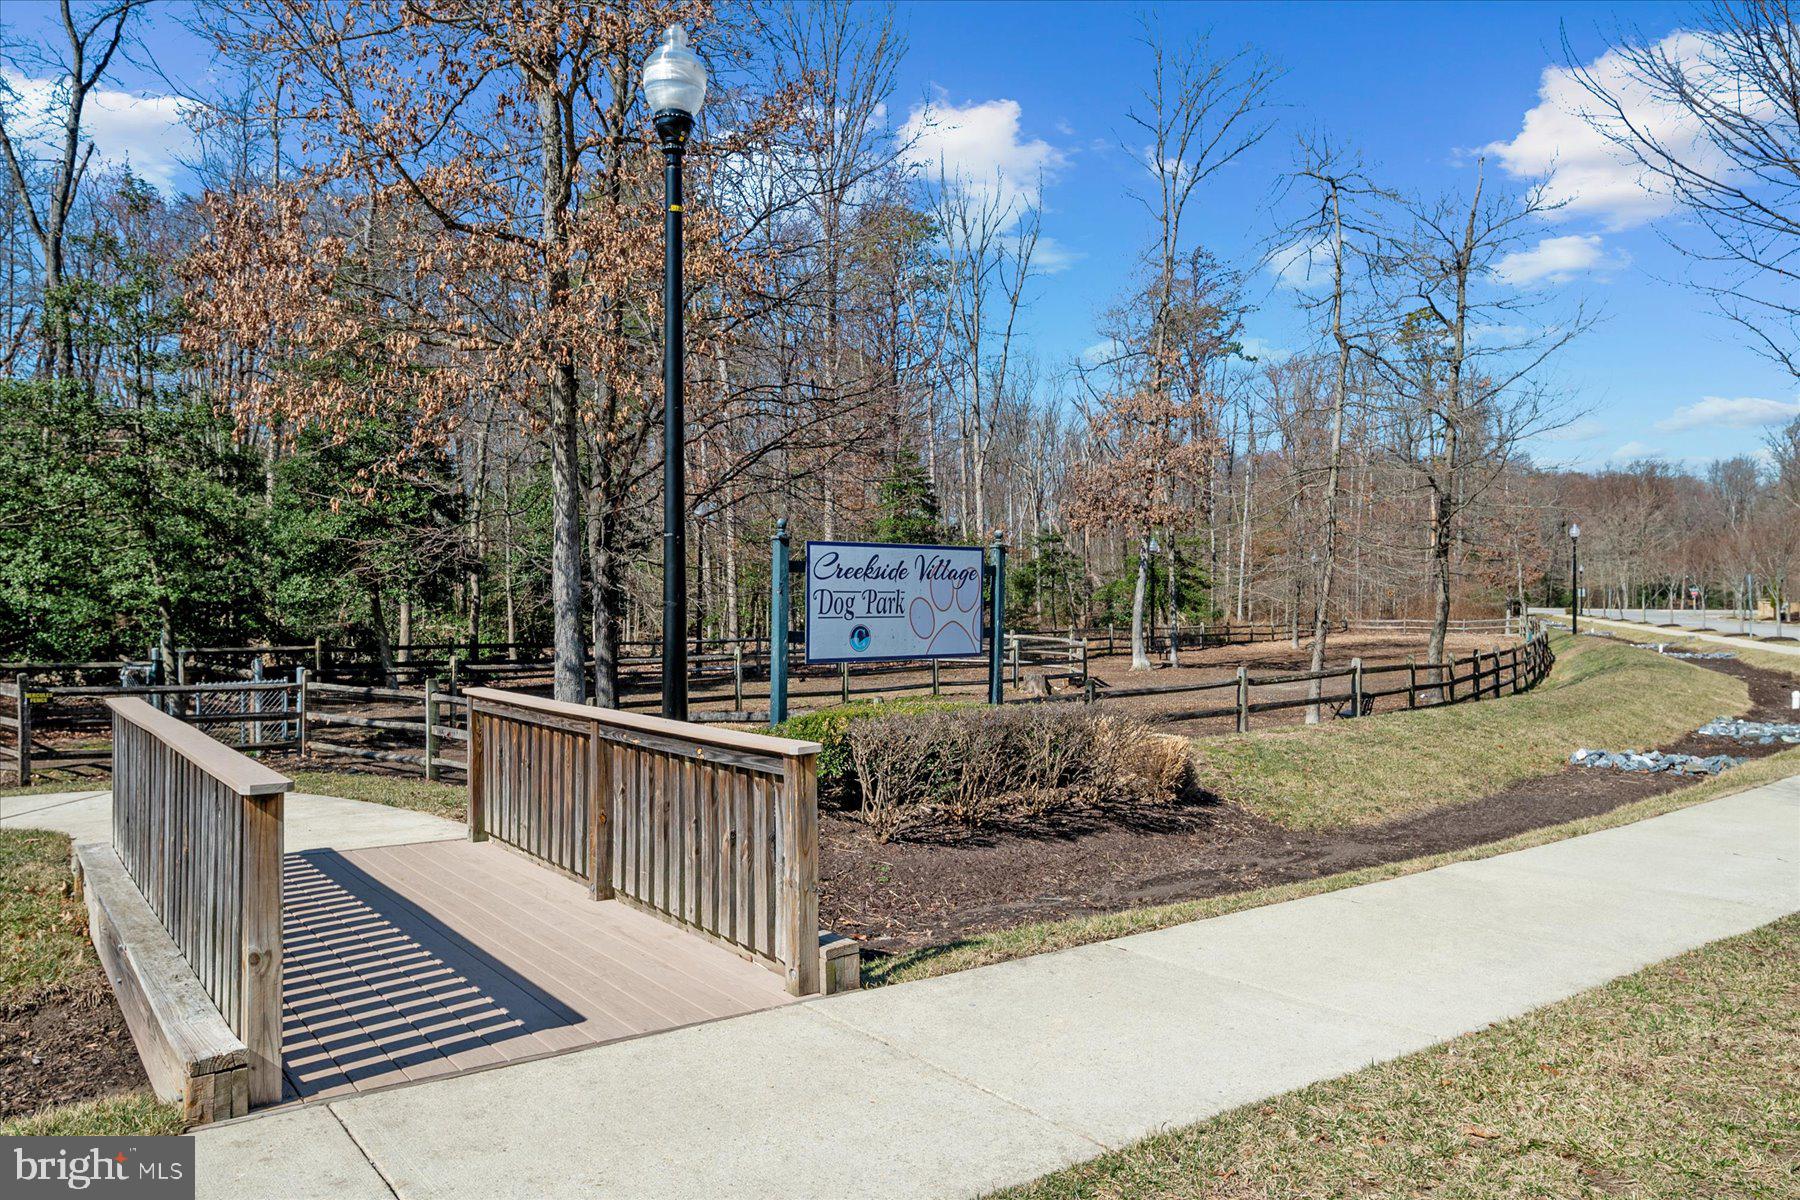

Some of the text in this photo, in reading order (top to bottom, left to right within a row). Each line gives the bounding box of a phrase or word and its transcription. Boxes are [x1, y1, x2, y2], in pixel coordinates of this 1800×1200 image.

[813, 551, 978, 589] Creekside Village
[812, 588, 906, 620] Dog Park
